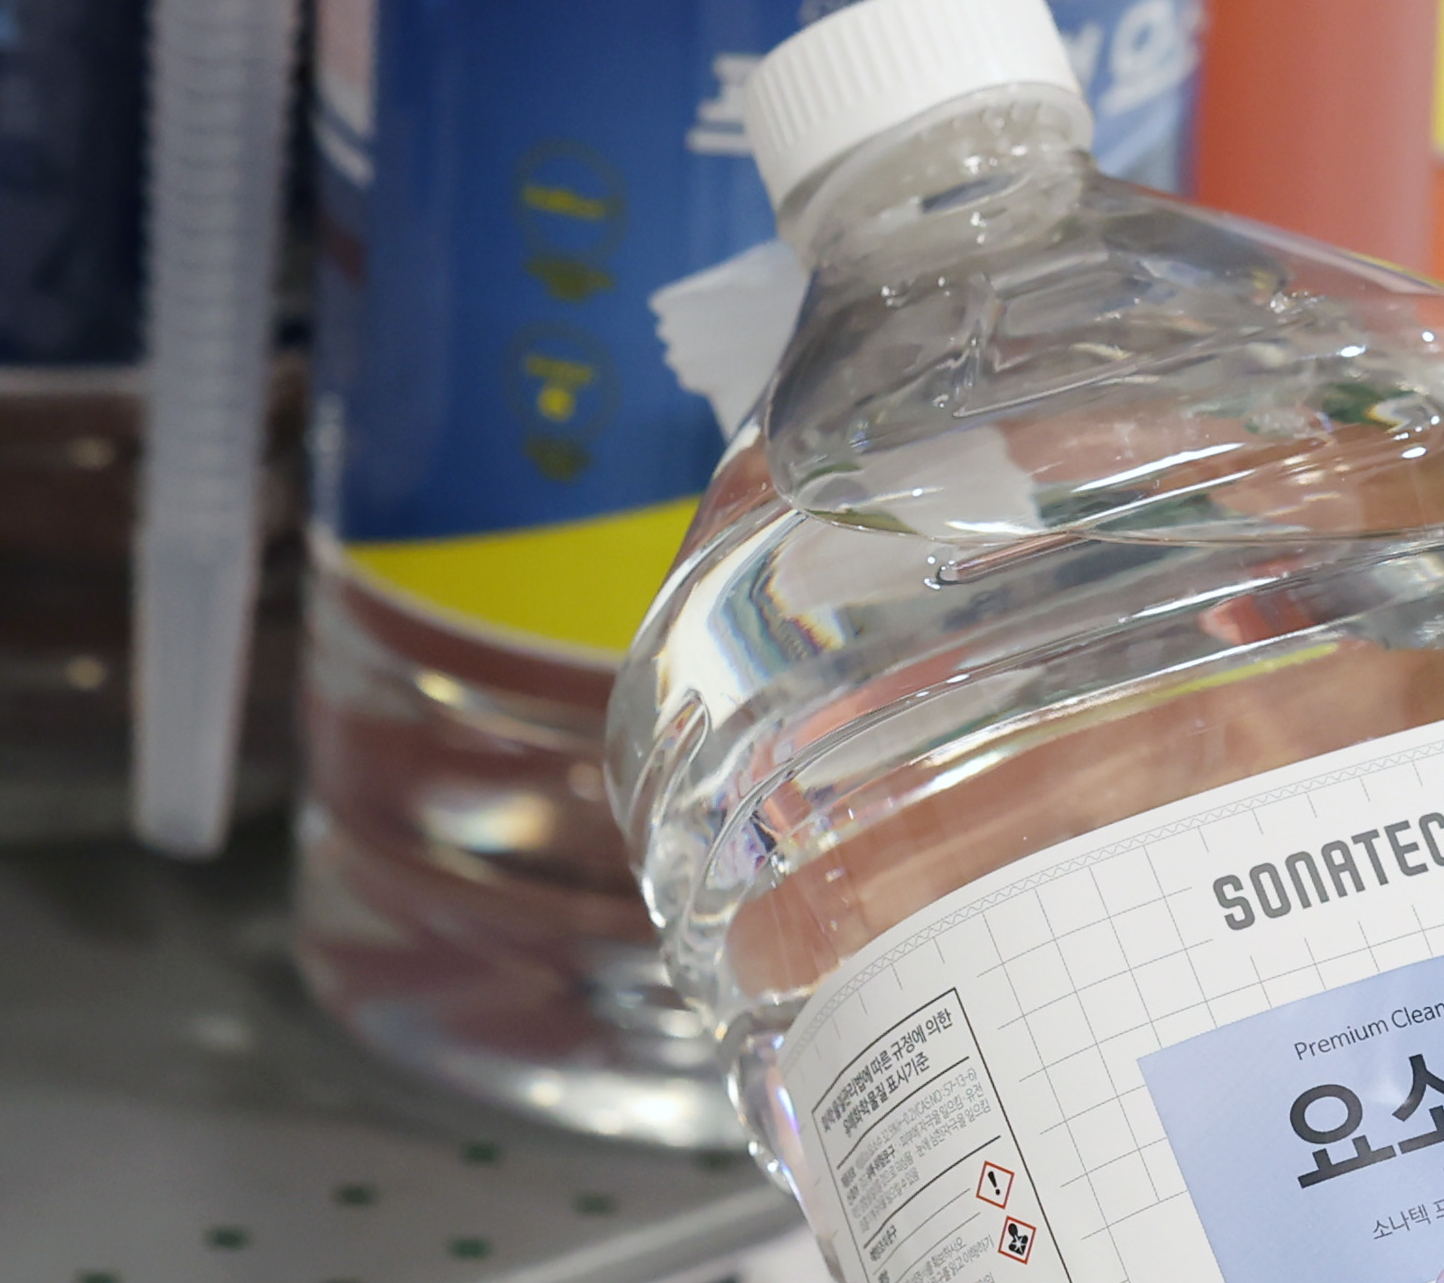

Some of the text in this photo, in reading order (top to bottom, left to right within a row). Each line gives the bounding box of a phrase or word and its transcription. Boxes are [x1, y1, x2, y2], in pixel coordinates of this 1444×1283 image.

[890, 1024, 928, 1061] 규정에
[925, 1008, 953, 1037] 의한
[1293, 1018, 1389, 1061] Premium
[886, 1051, 930, 1095] 표시기준
[1372, 1207, 1431, 1241] 소나텍
